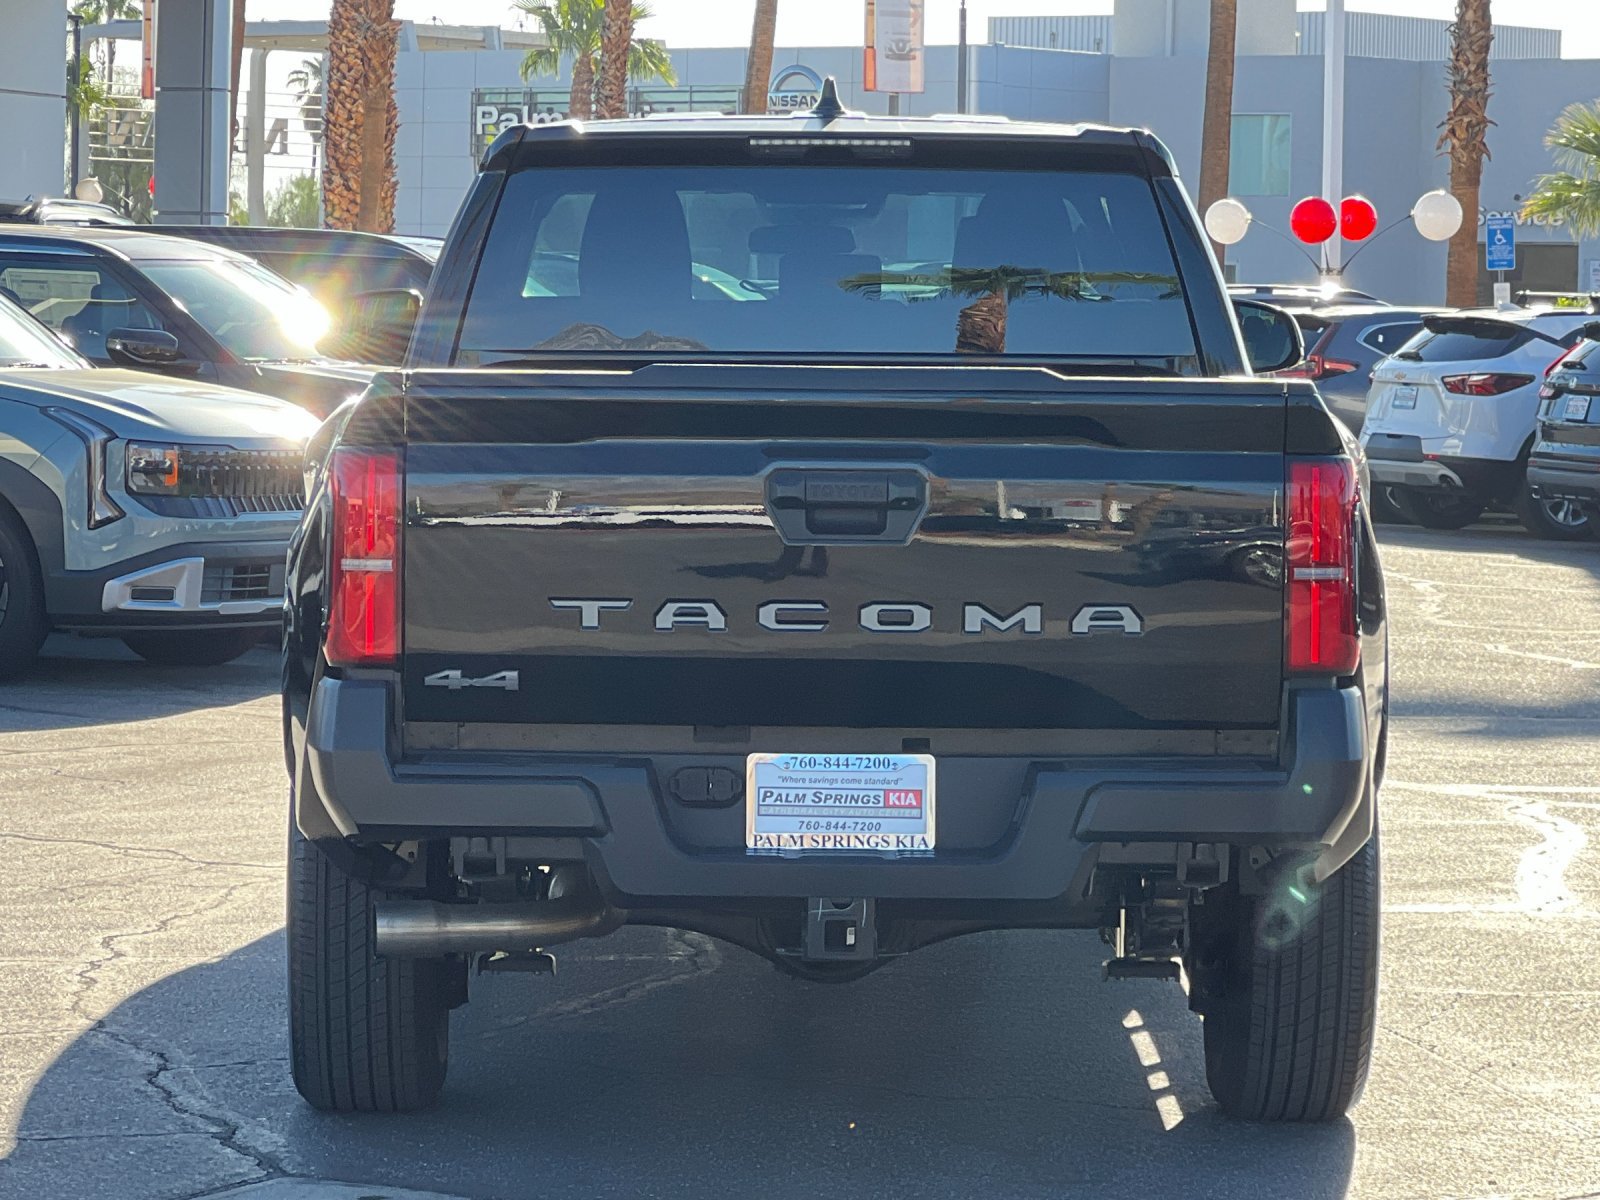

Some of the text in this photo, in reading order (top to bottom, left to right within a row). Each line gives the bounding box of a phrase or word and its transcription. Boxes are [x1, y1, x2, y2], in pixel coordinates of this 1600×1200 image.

[769, 95, 820, 107] NISSAN
[810, 483, 885, 498] TOYOTA
[548, 597, 1145, 634] TACOMA
[790, 756, 891, 769] 760-844-7200
[808, 776, 838, 787] savings
[840, 777, 864, 786] come
[761, 789, 917, 806] PALM SPRINGS KIA
[798, 821, 882, 832] 760-844-7200
[753, 834, 930, 848] PALM SPRINGS KIA
